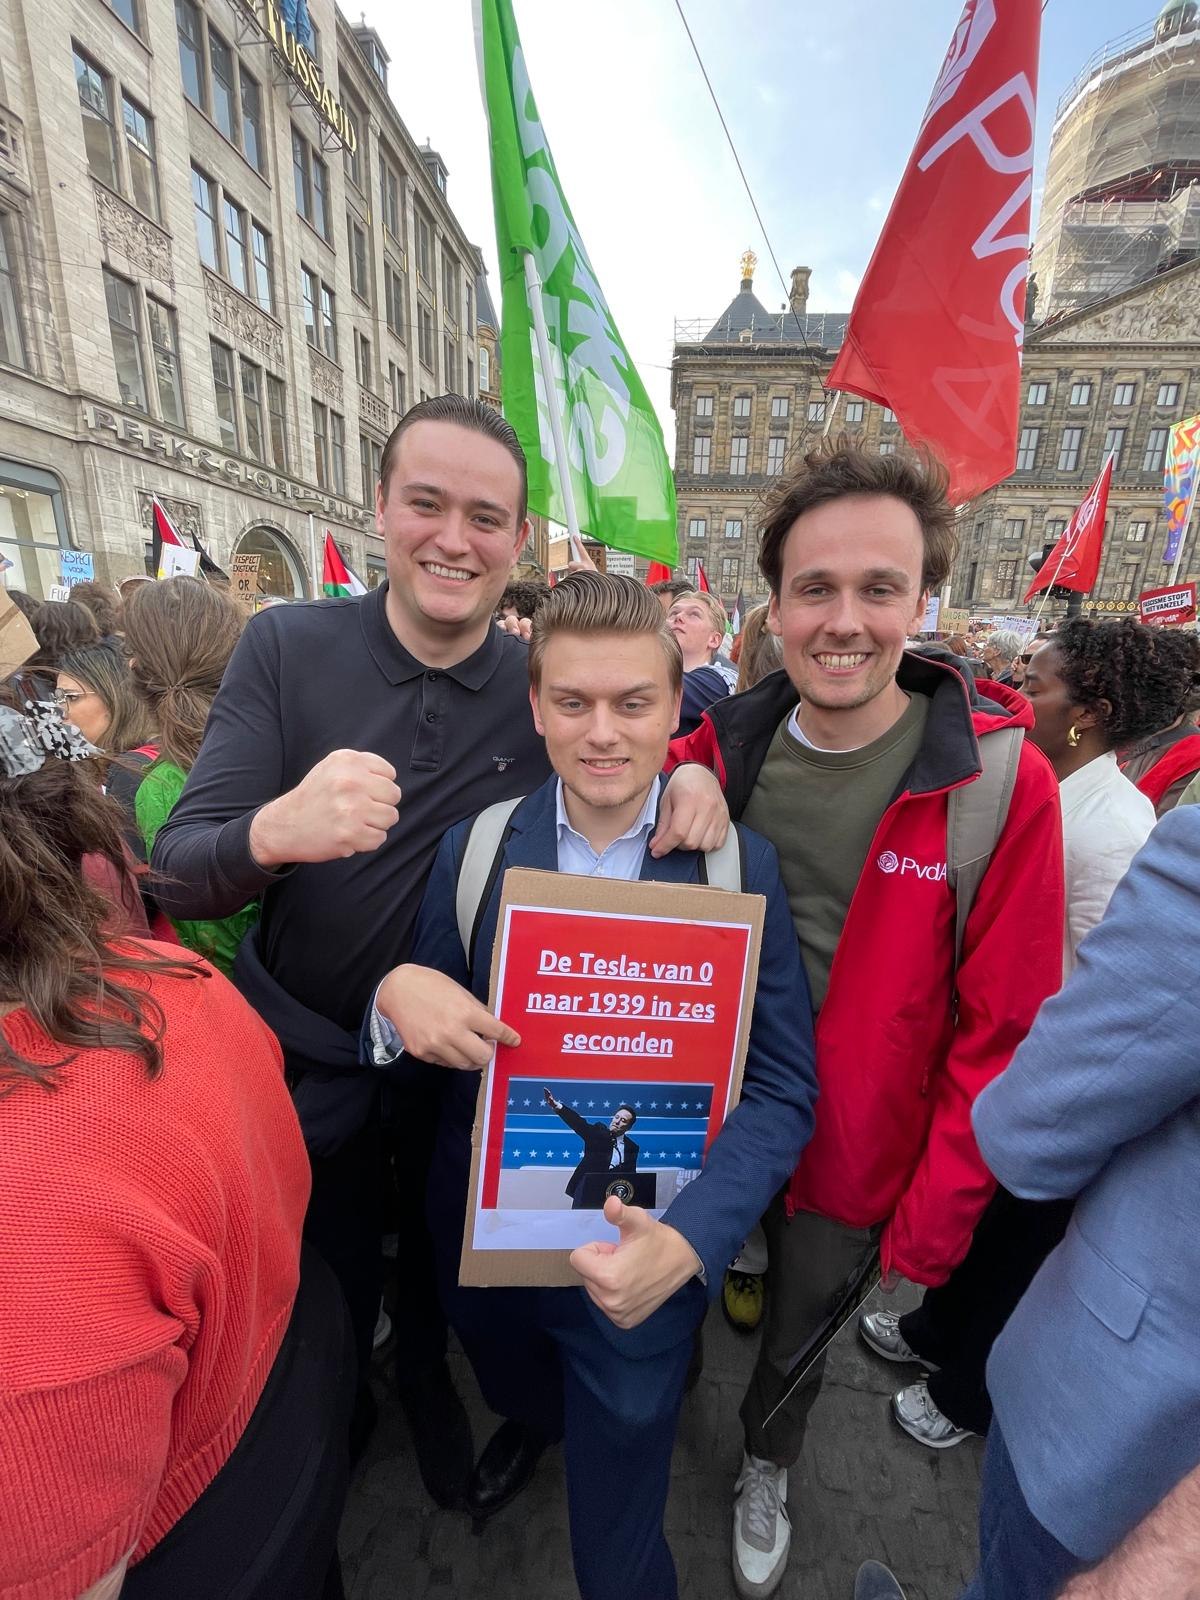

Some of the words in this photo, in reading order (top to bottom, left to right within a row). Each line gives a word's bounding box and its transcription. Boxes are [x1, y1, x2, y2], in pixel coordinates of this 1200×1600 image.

[84, 405, 188, 461] PEEK
[61, 551, 90, 565] RESPECT
[235, 555, 259, 564] RESPECT
[238, 579, 250, 591] OR
[1167, 592, 1189, 601] STOPT
[1157, 600, 1184, 610] VANZELF
[539, 950, 572, 973] De
[579, 953, 647, 978] Tesla:
[653, 962, 693, 982] van
[699, 961, 714, 983] 0
[528, 992, 583, 1012] naar
[587, 992, 645, 1016] 1939
[651, 995, 672, 1017] in
[677, 1002, 716, 1020] zes
[562, 1031, 673, 1055] seconden
